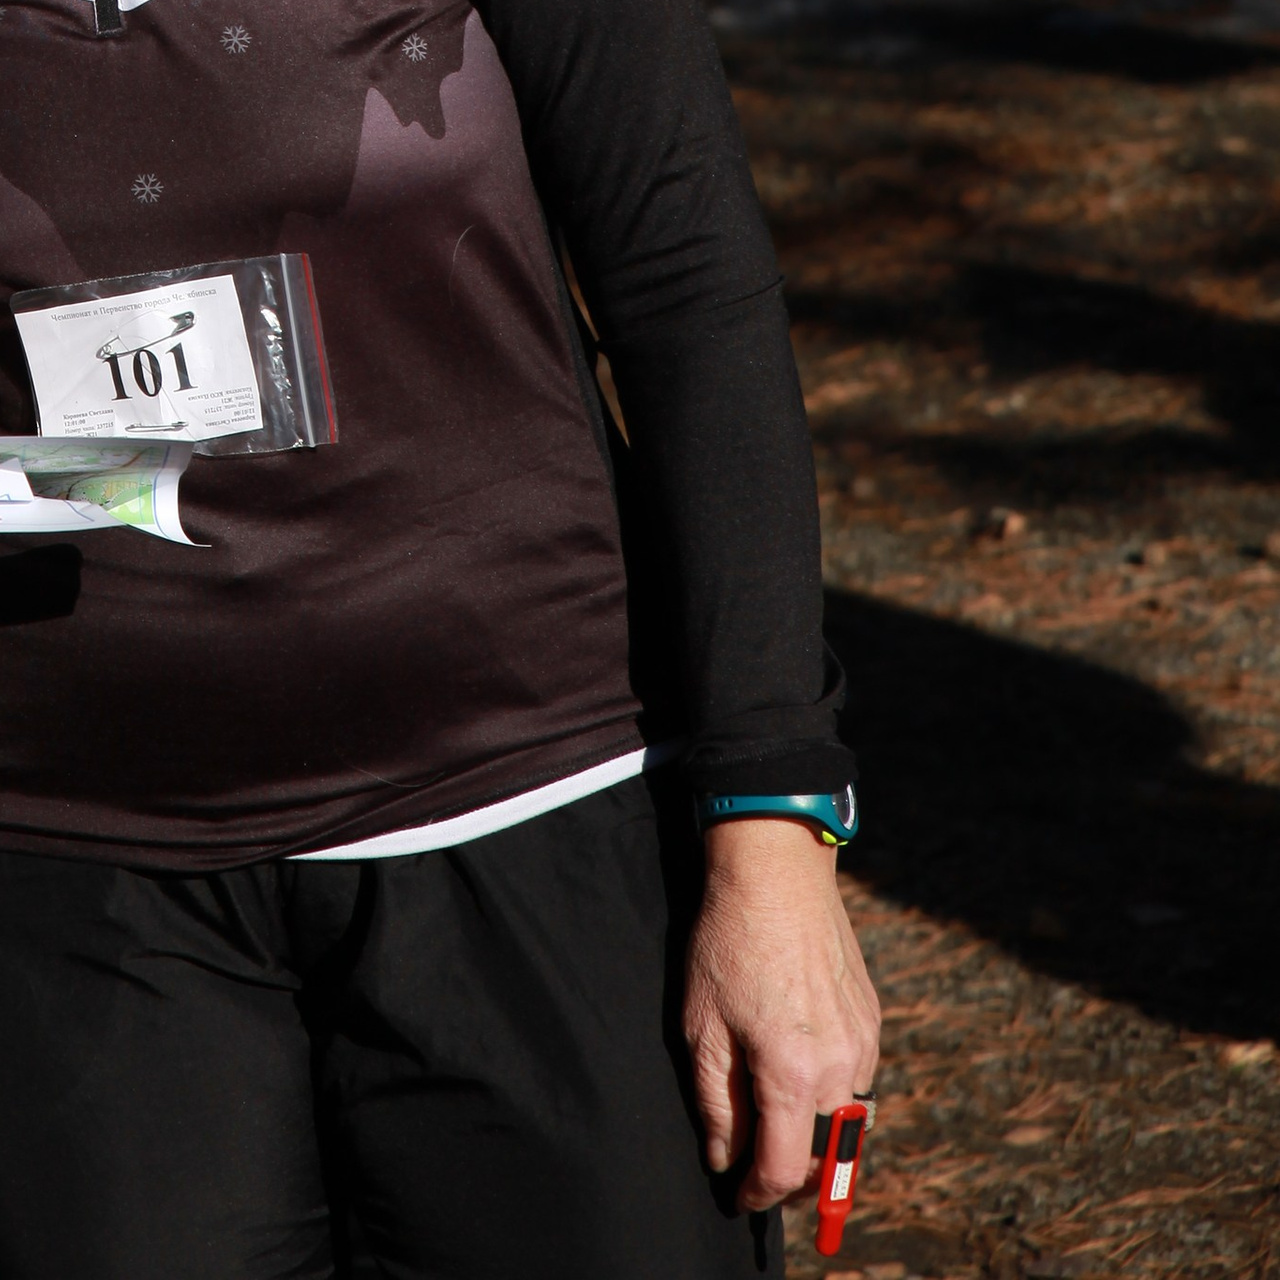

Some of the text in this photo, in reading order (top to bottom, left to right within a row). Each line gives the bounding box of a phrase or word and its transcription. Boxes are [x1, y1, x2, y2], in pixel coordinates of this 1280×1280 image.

[51, 310, 91, 322] Чемпионат
[93, 309, 99, 317] и
[100, 302, 143, 315] Первенство
[144, 297, 170, 309] города
[102, 342, 198, 401] 101
